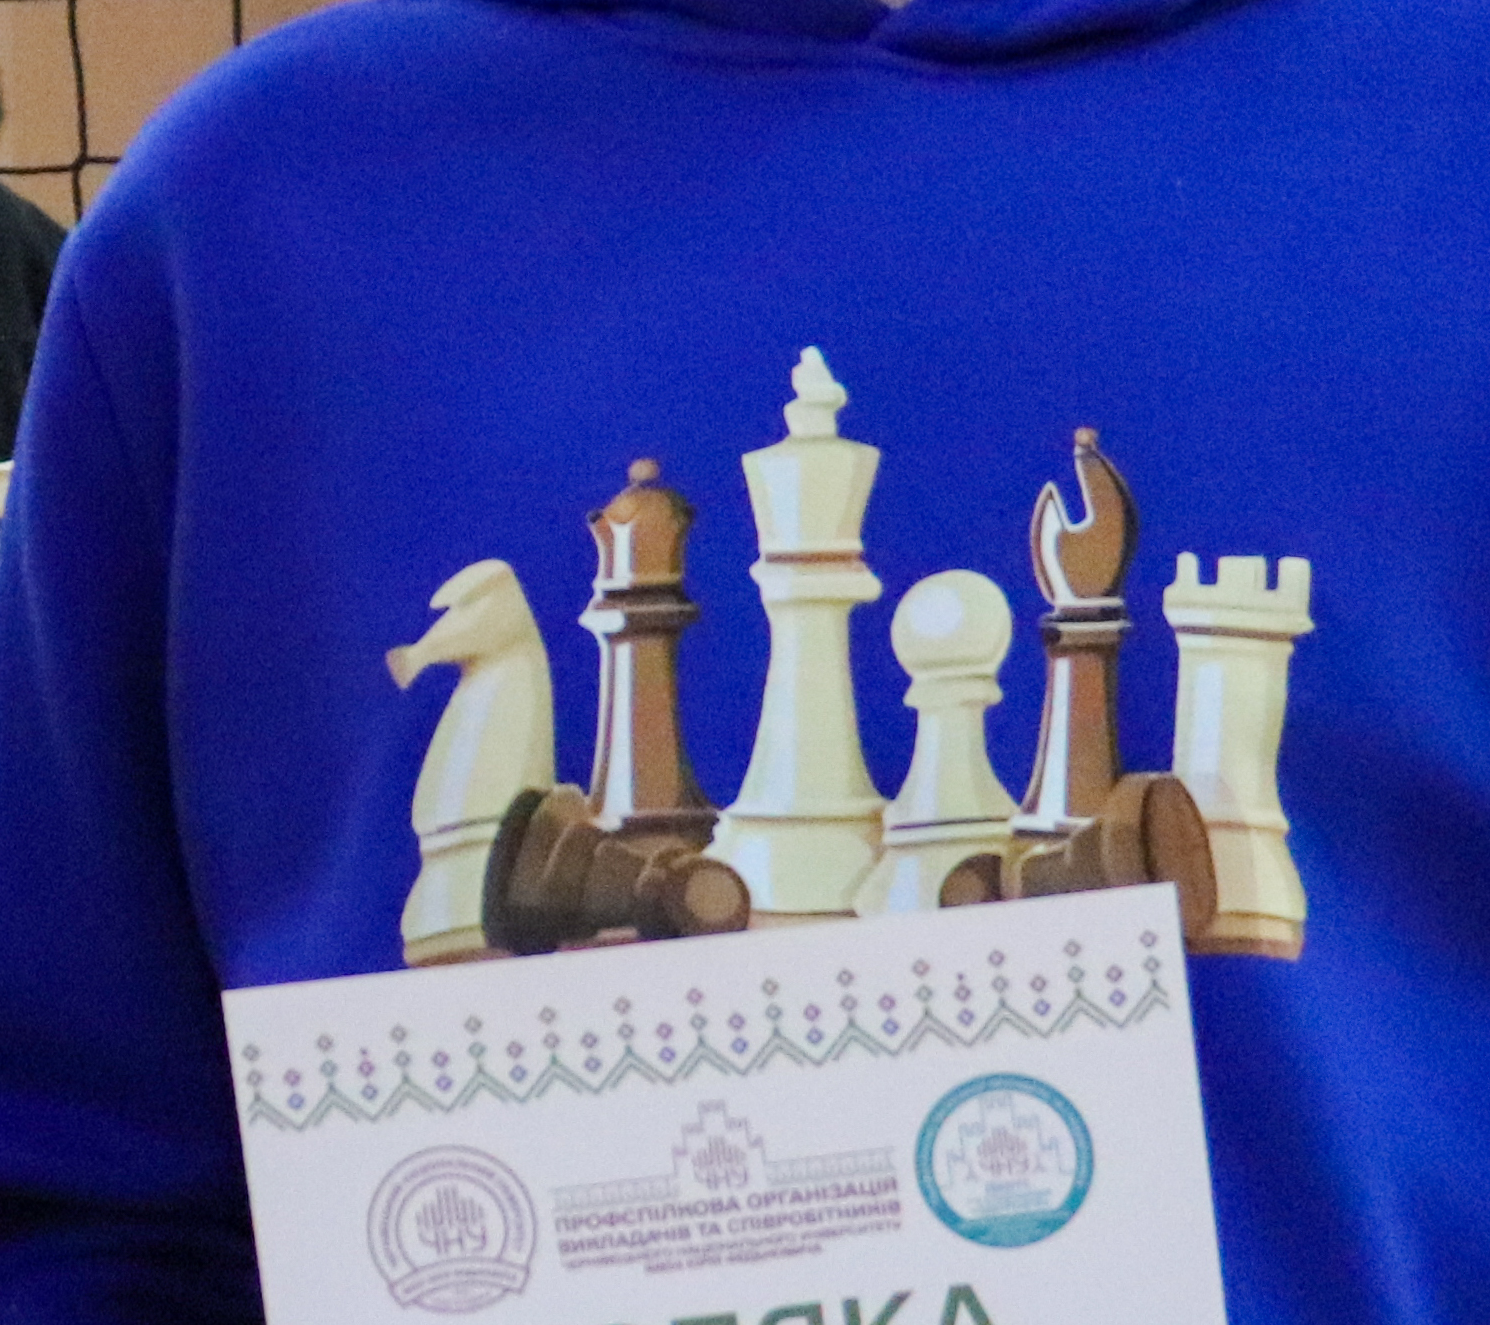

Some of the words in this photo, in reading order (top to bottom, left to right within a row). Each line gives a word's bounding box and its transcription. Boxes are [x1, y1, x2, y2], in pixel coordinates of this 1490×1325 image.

[554, 1195, 740, 1232] ПРОФСПІЛКОВА
[557, 1224, 691, 1256] ВИКЛАДАЧІВ
[696, 1221, 722, 1237] ТА
[726, 1198, 901, 1234] СПІВРОБІТНИКІВ
